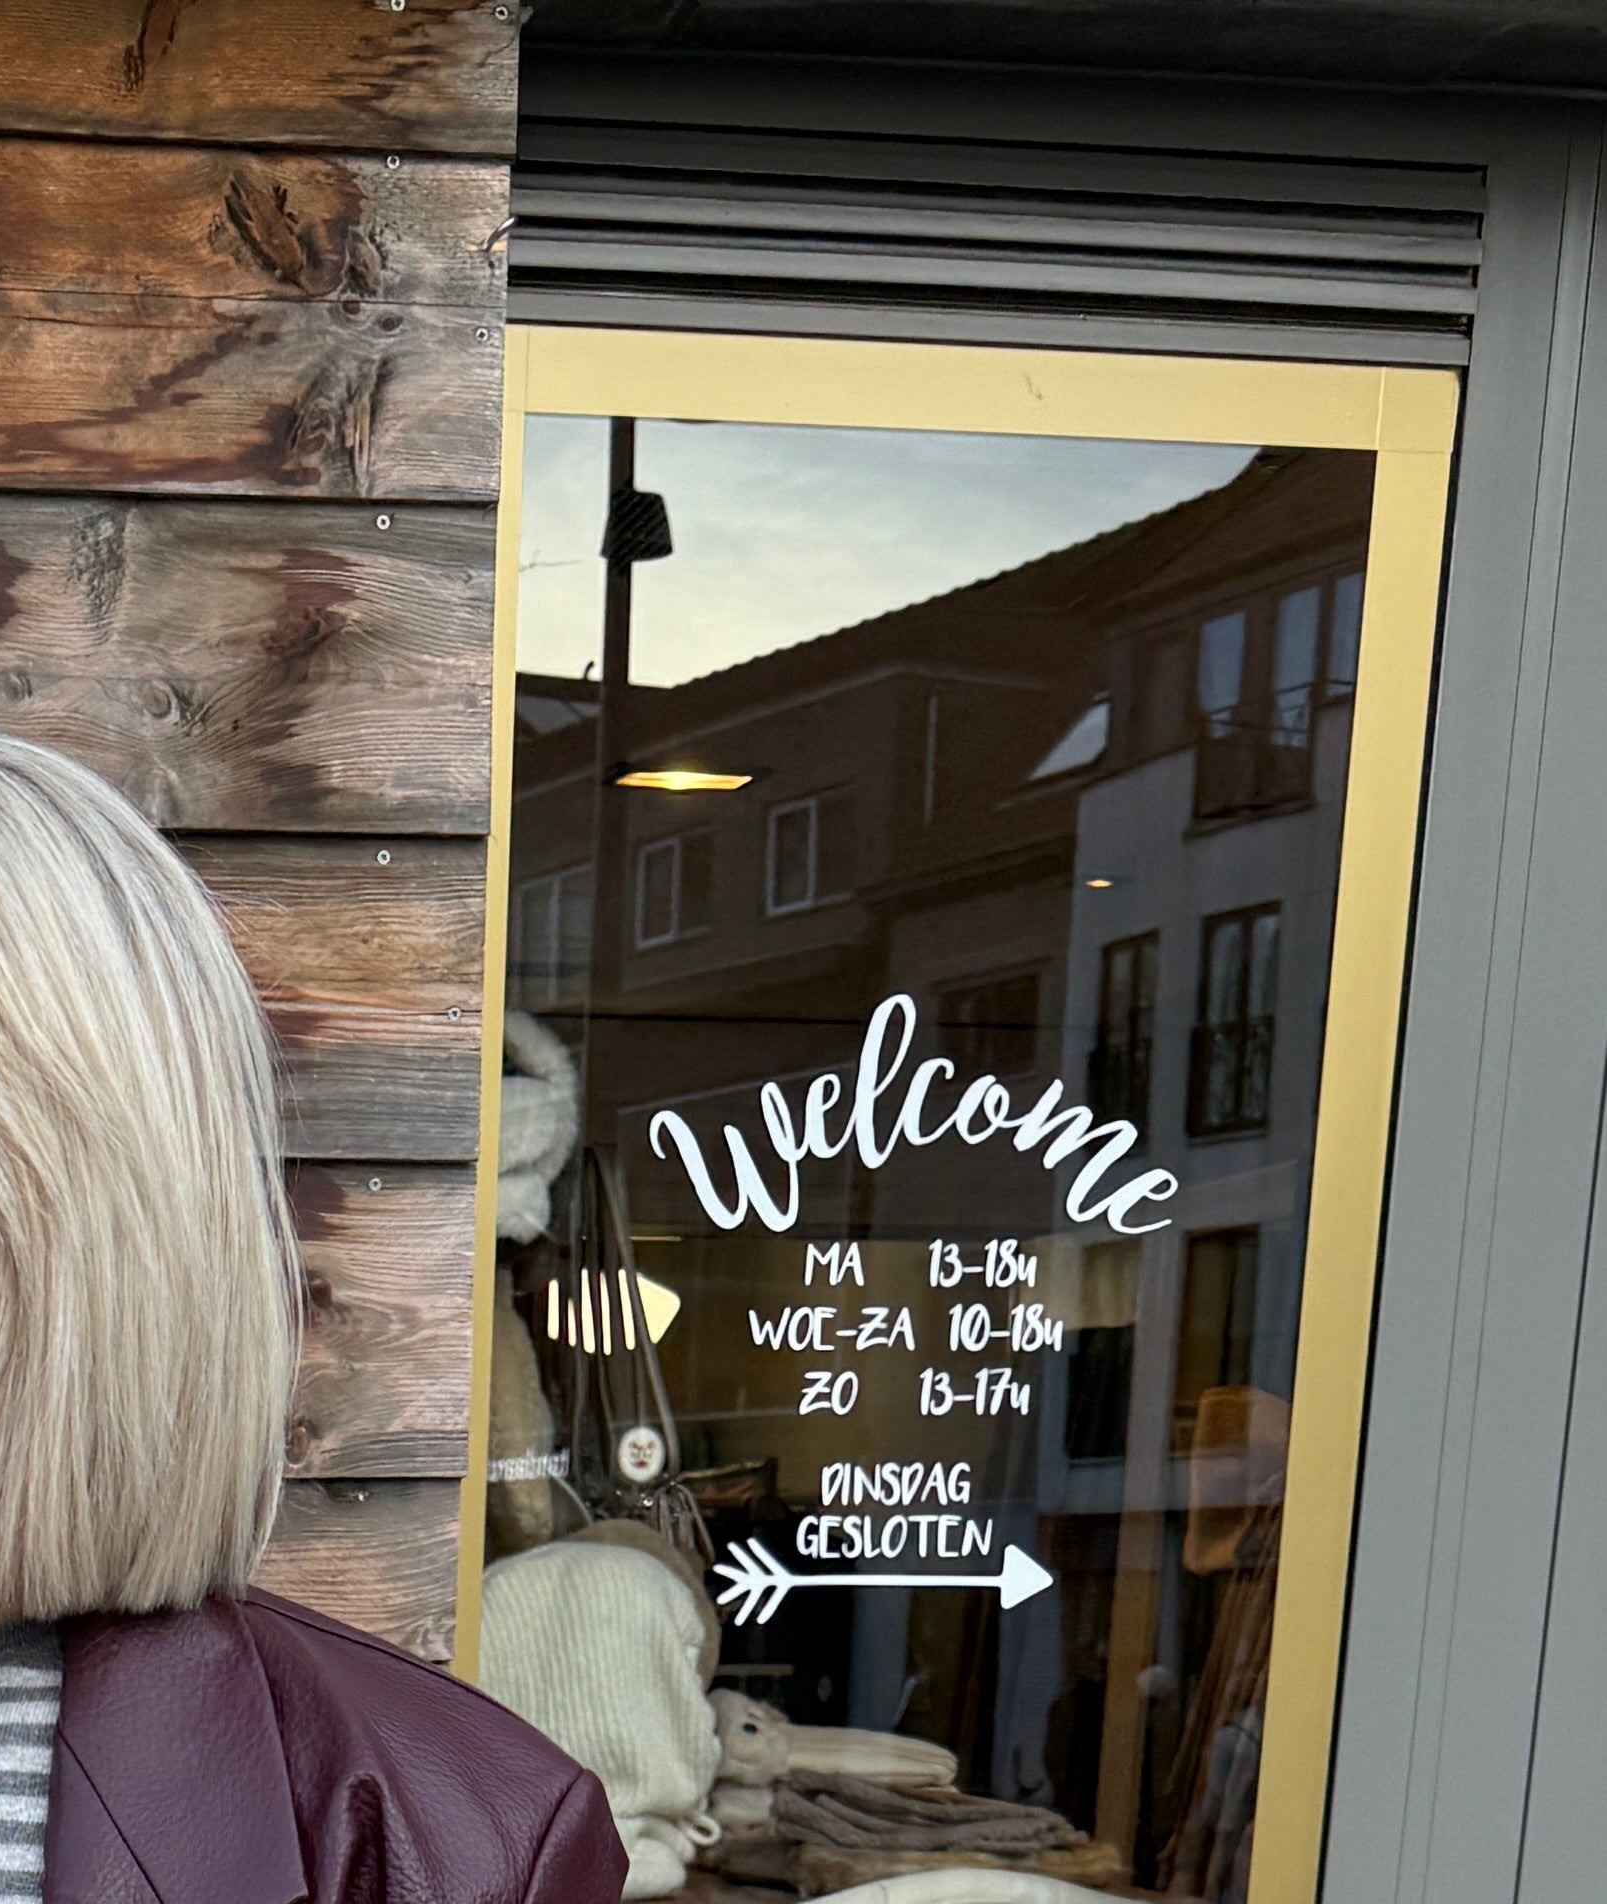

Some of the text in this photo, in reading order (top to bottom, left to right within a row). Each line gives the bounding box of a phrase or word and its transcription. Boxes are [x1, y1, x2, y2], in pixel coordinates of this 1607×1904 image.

[649, 993, 1179, 1234] Welcome
[804, 1239, 1037, 1288] MA 13-18u
[748, 1306, 915, 1351] WOE-ZA
[798, 1367, 1030, 1416] ZO 13-17u
[821, 1462, 971, 1506] DINSDAG
[796, 1514, 993, 1559] GESLOTEN
